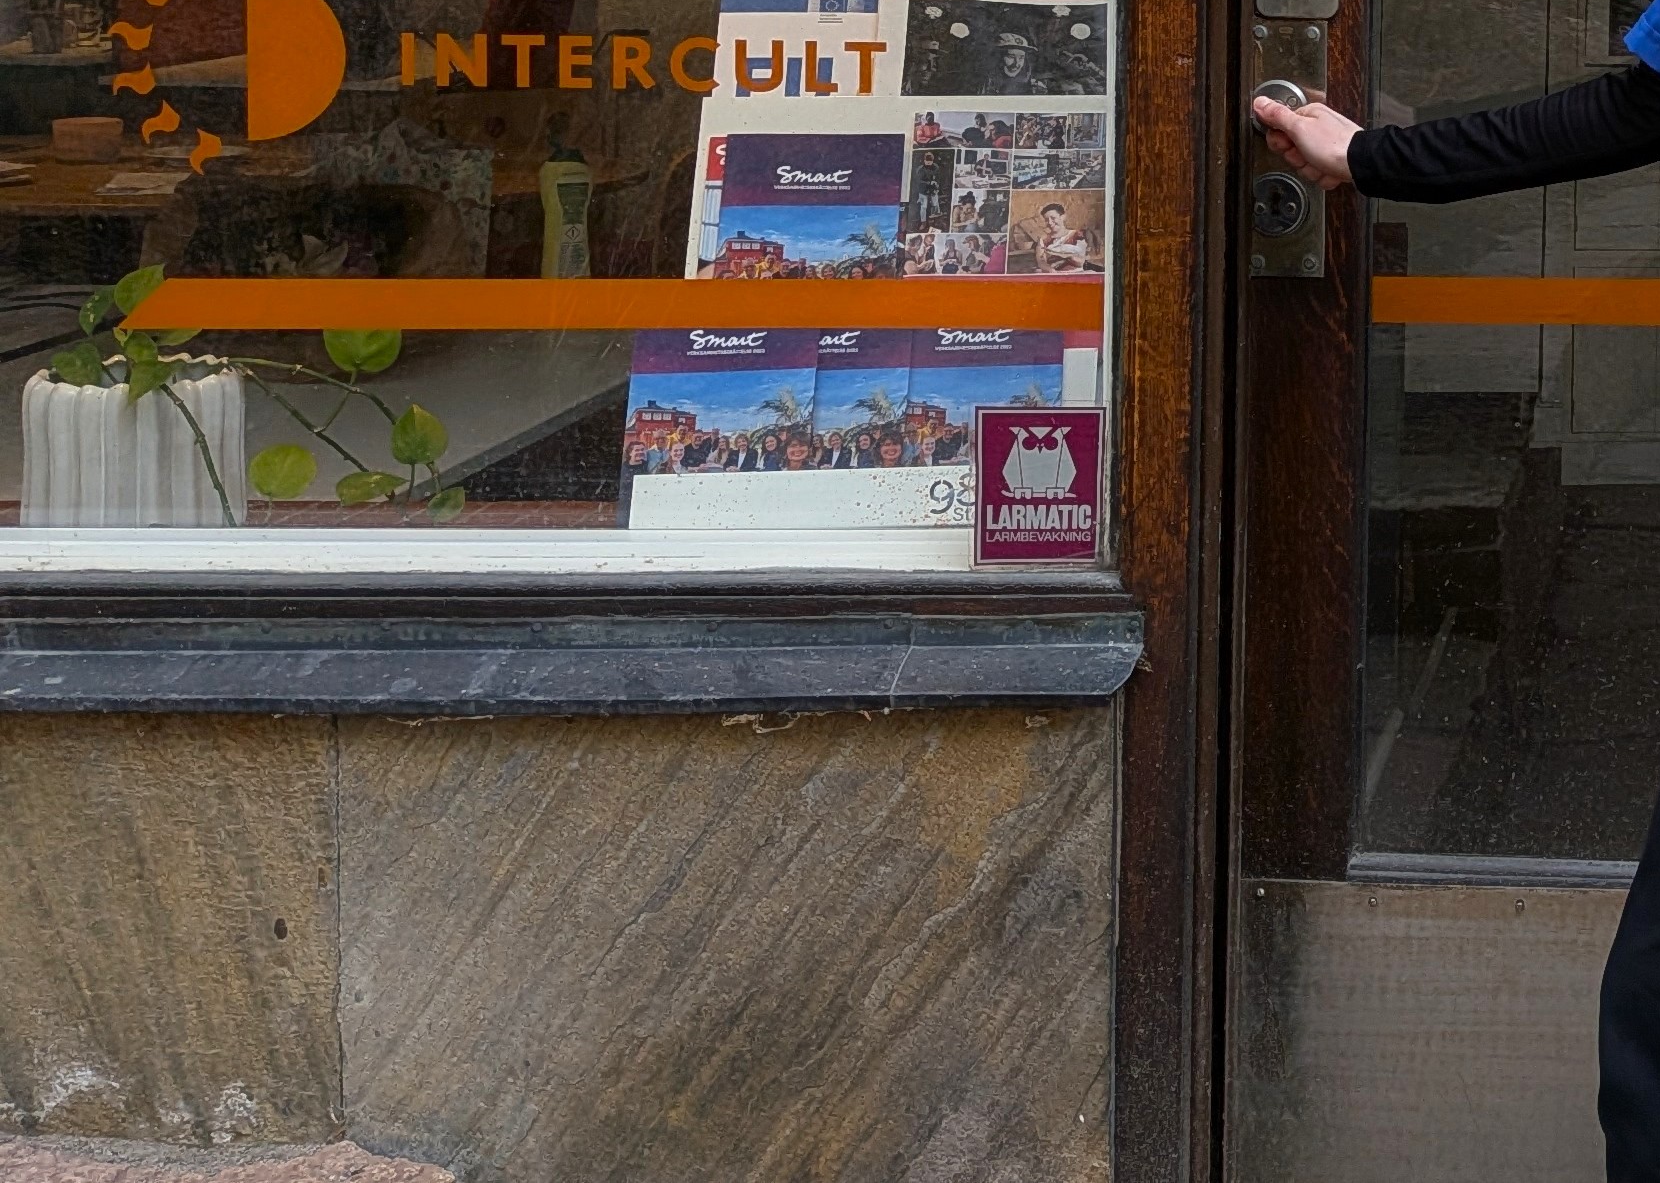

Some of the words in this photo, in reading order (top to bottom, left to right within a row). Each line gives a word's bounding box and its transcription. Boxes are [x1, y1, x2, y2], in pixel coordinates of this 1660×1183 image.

[400, 31, 888, 94] INTERCULT
[775, 164, 853, 185] Smart
[688, 329, 768, 350] Smart
[936, 327, 1014, 346] Smart
[985, 503, 1093, 530] LARMATIC
[985, 531, 1093, 544] LARMBEVAKNING
